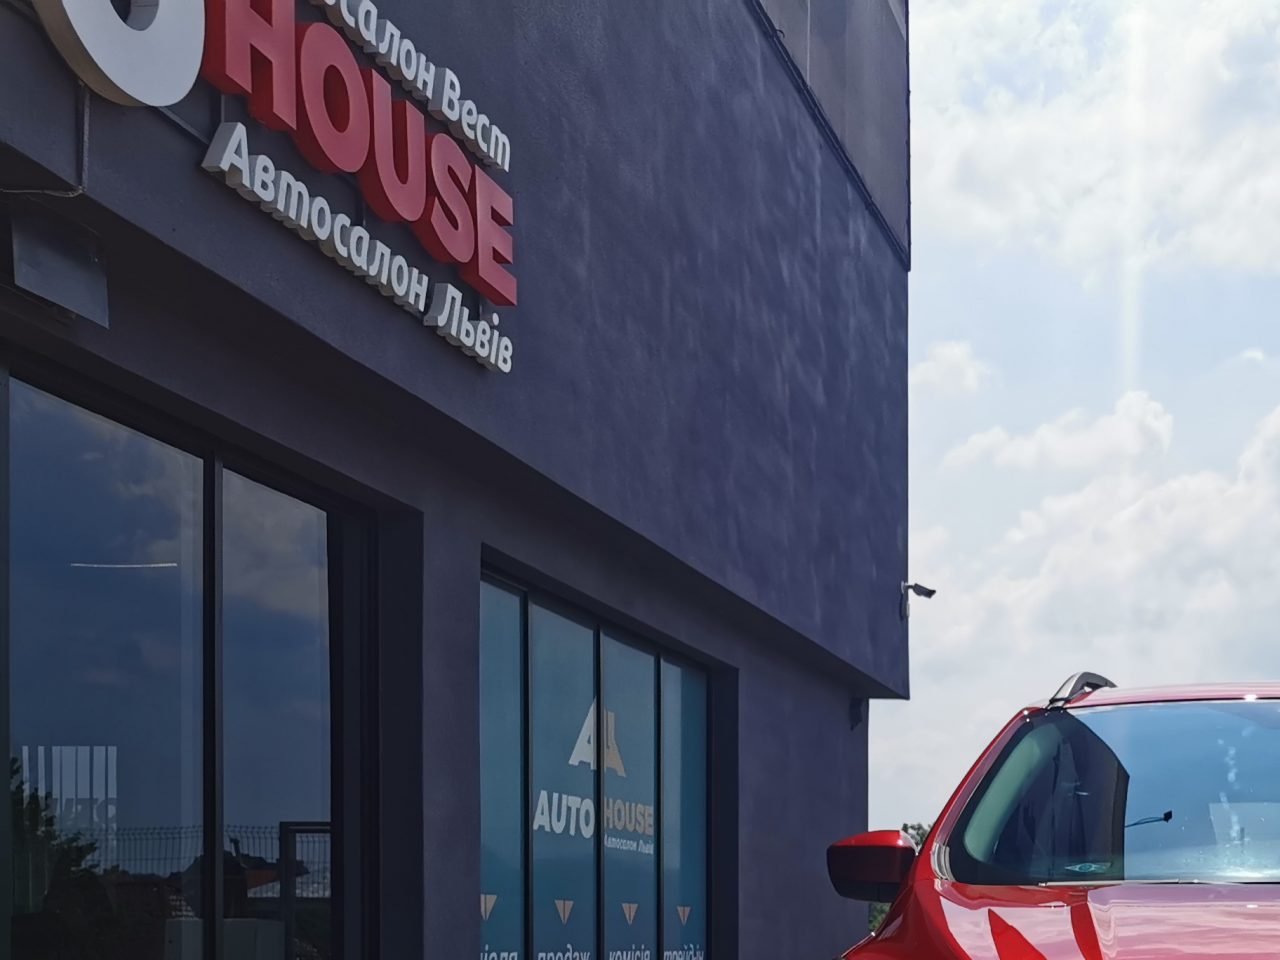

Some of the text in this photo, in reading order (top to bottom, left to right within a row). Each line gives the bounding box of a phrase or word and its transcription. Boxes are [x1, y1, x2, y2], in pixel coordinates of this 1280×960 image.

[224, 0, 517, 306] HOUSE
[325, 0, 435, 100] салон
[441, 68, 511, 173] Вест
[218, 121, 514, 374] Автосалон Львів
[533, 790, 654, 839] AUTO HOUSE
